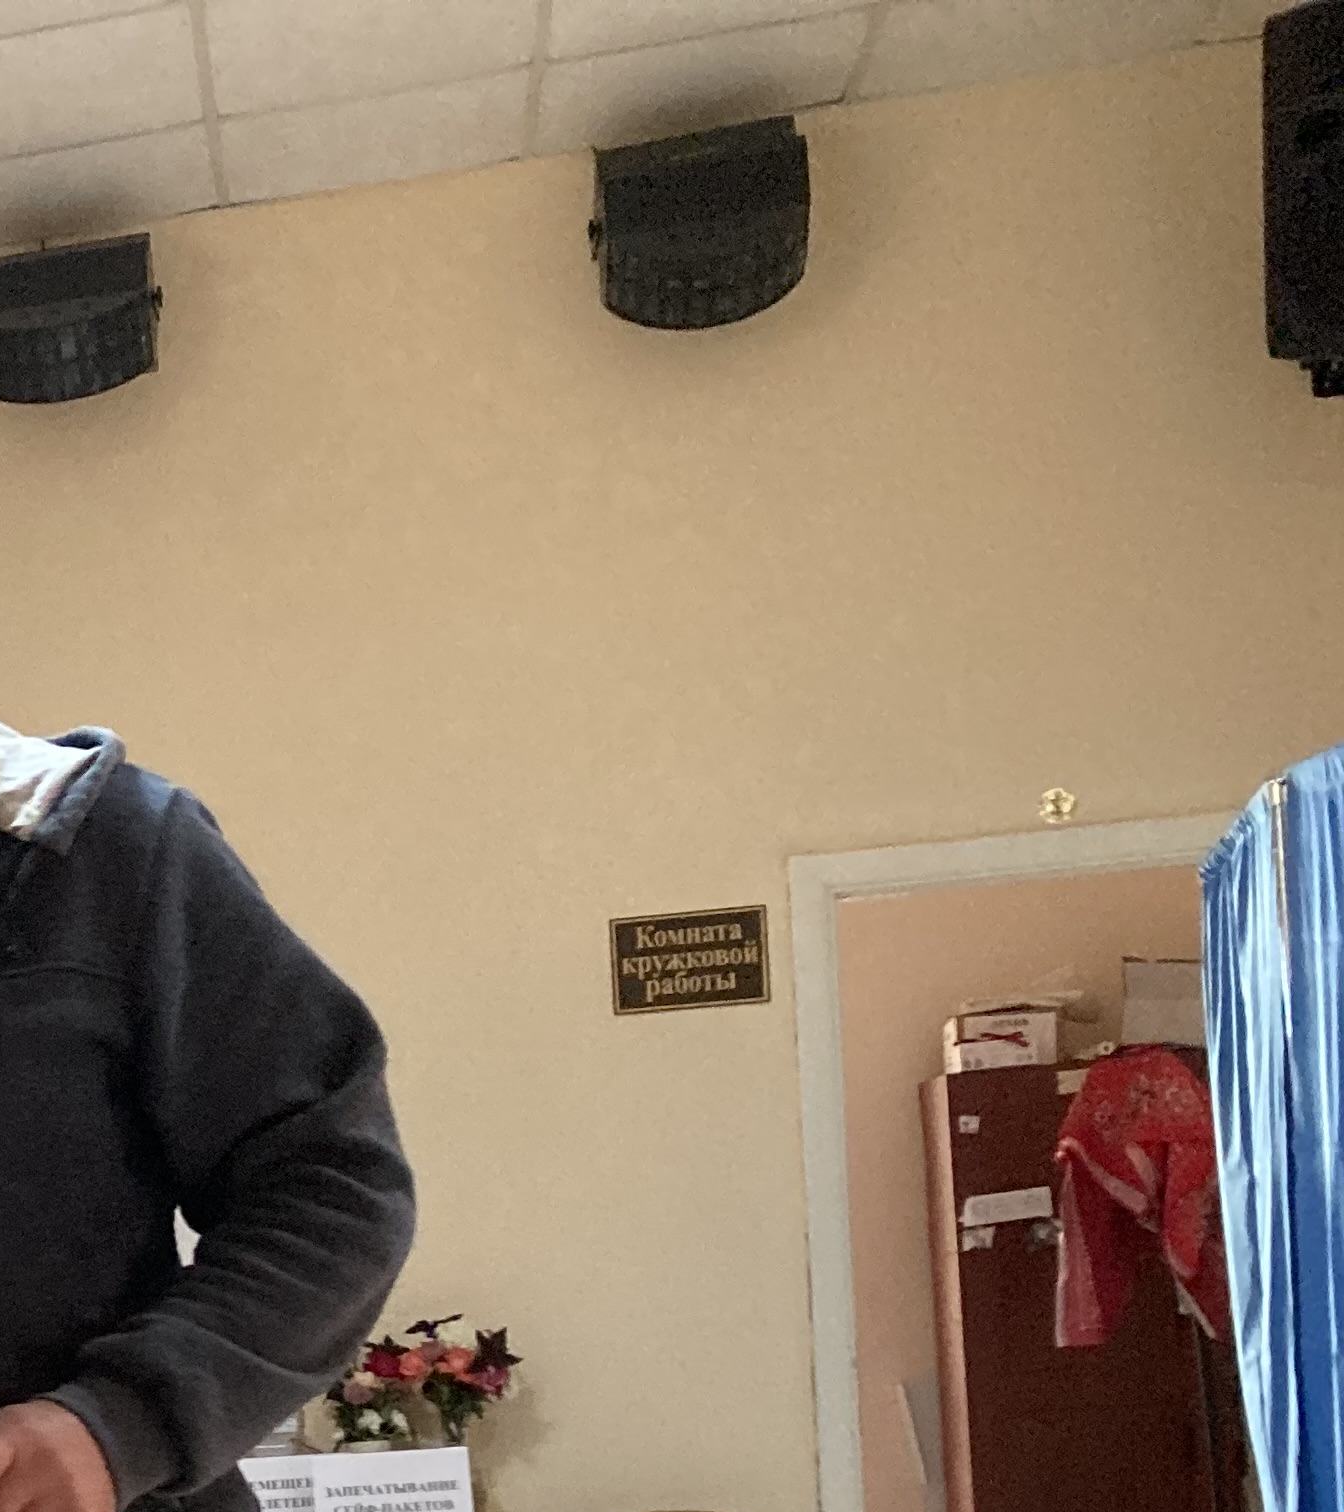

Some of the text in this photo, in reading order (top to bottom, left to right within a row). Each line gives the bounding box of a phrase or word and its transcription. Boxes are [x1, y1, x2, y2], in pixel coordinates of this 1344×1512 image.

[635, 922, 743, 950] Комната
[621, 939, 759, 981] кружковой
[645, 970, 737, 1003] работы
[325, 1480, 458, 1498] ЗАПЕЧАТЫВАНИЕ
